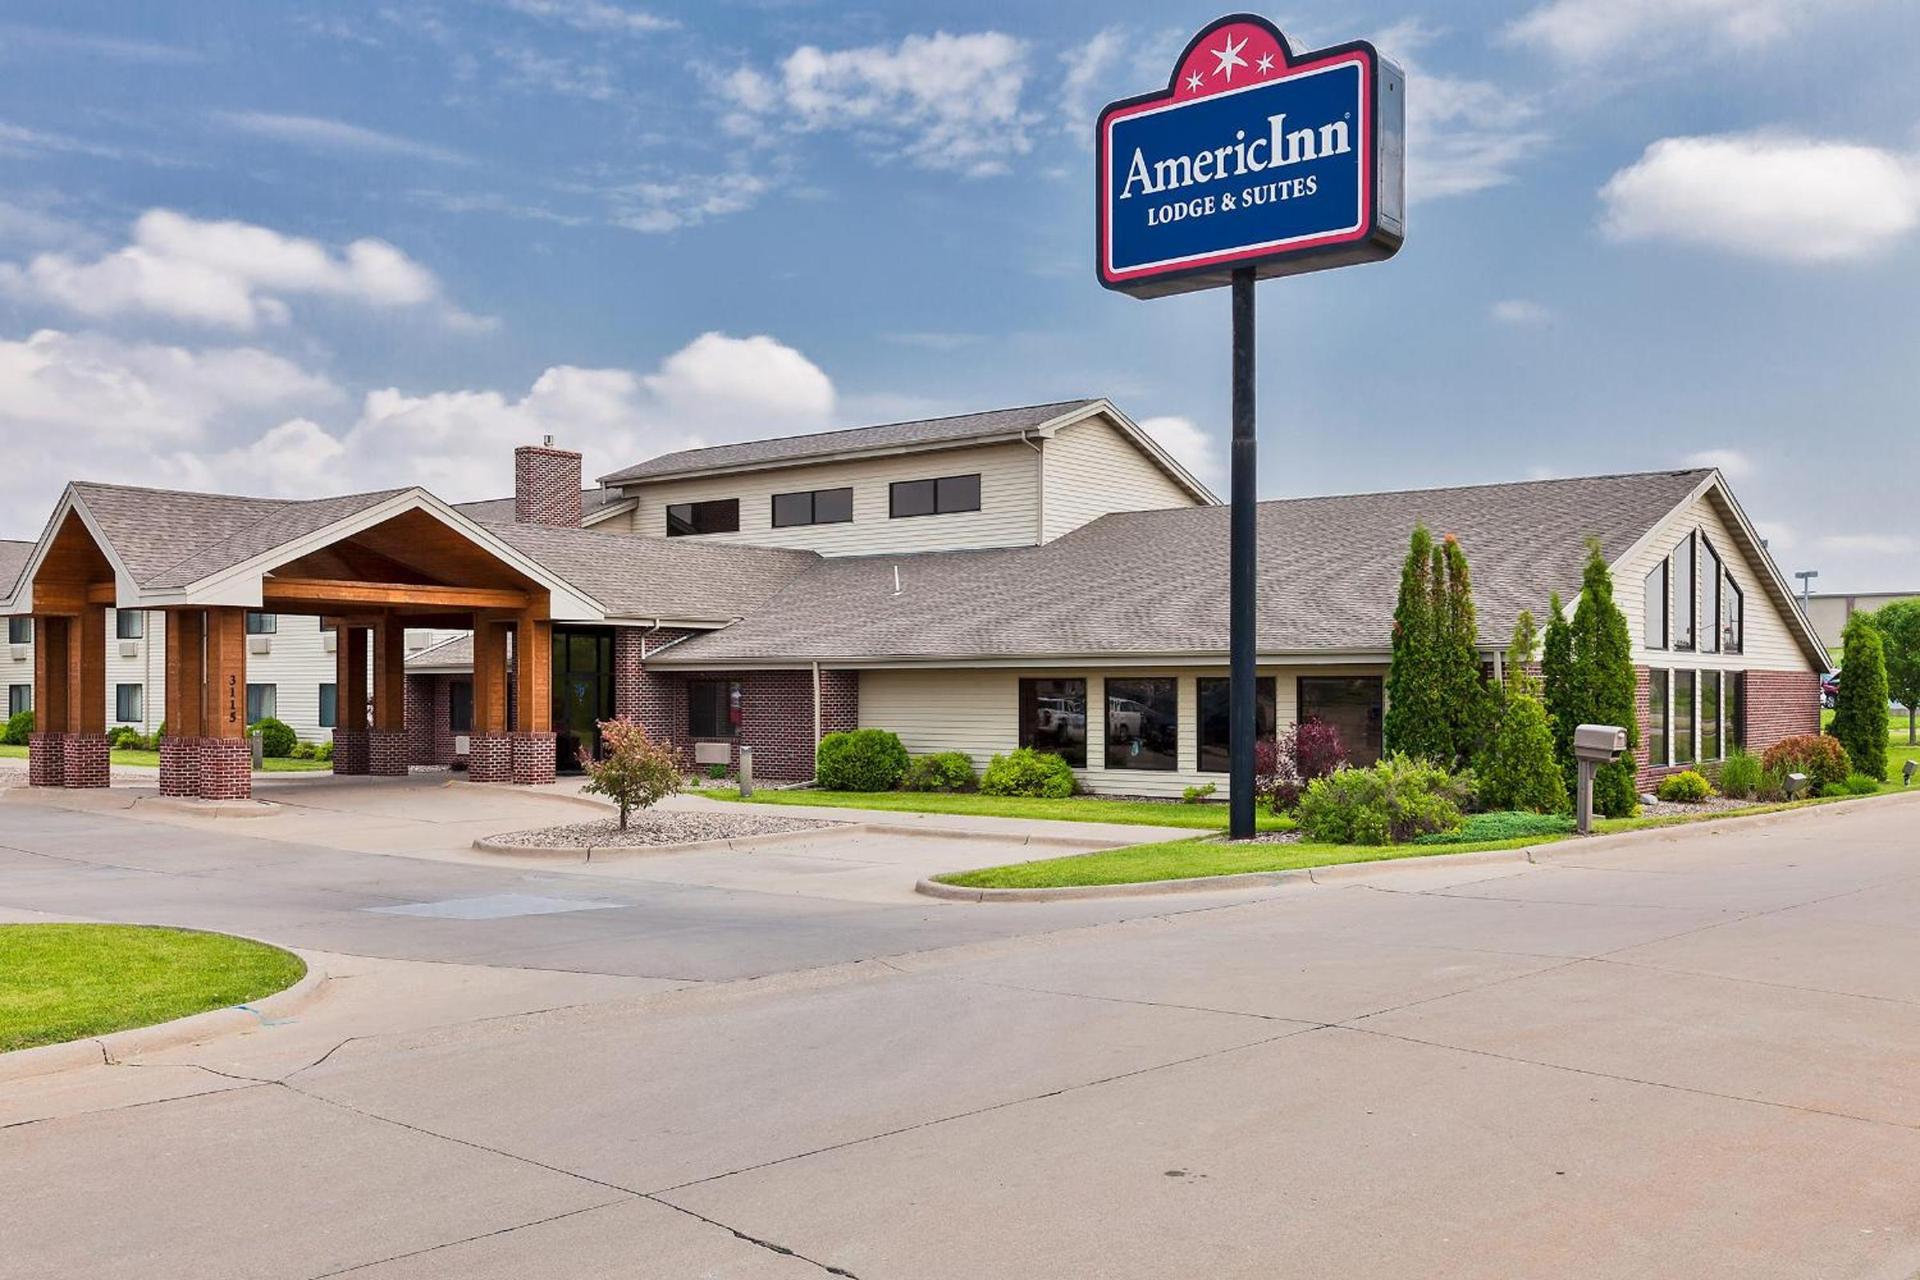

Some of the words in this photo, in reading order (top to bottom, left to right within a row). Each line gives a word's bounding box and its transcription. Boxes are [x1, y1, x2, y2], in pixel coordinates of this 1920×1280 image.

[1119, 113, 1351, 199] AmericInn
[1147, 196, 1216, 226] LODGE
[1221, 193, 1236, 212] &
[1242, 175, 1318, 207] SUITES
[228, 674, 237, 723] 3115
